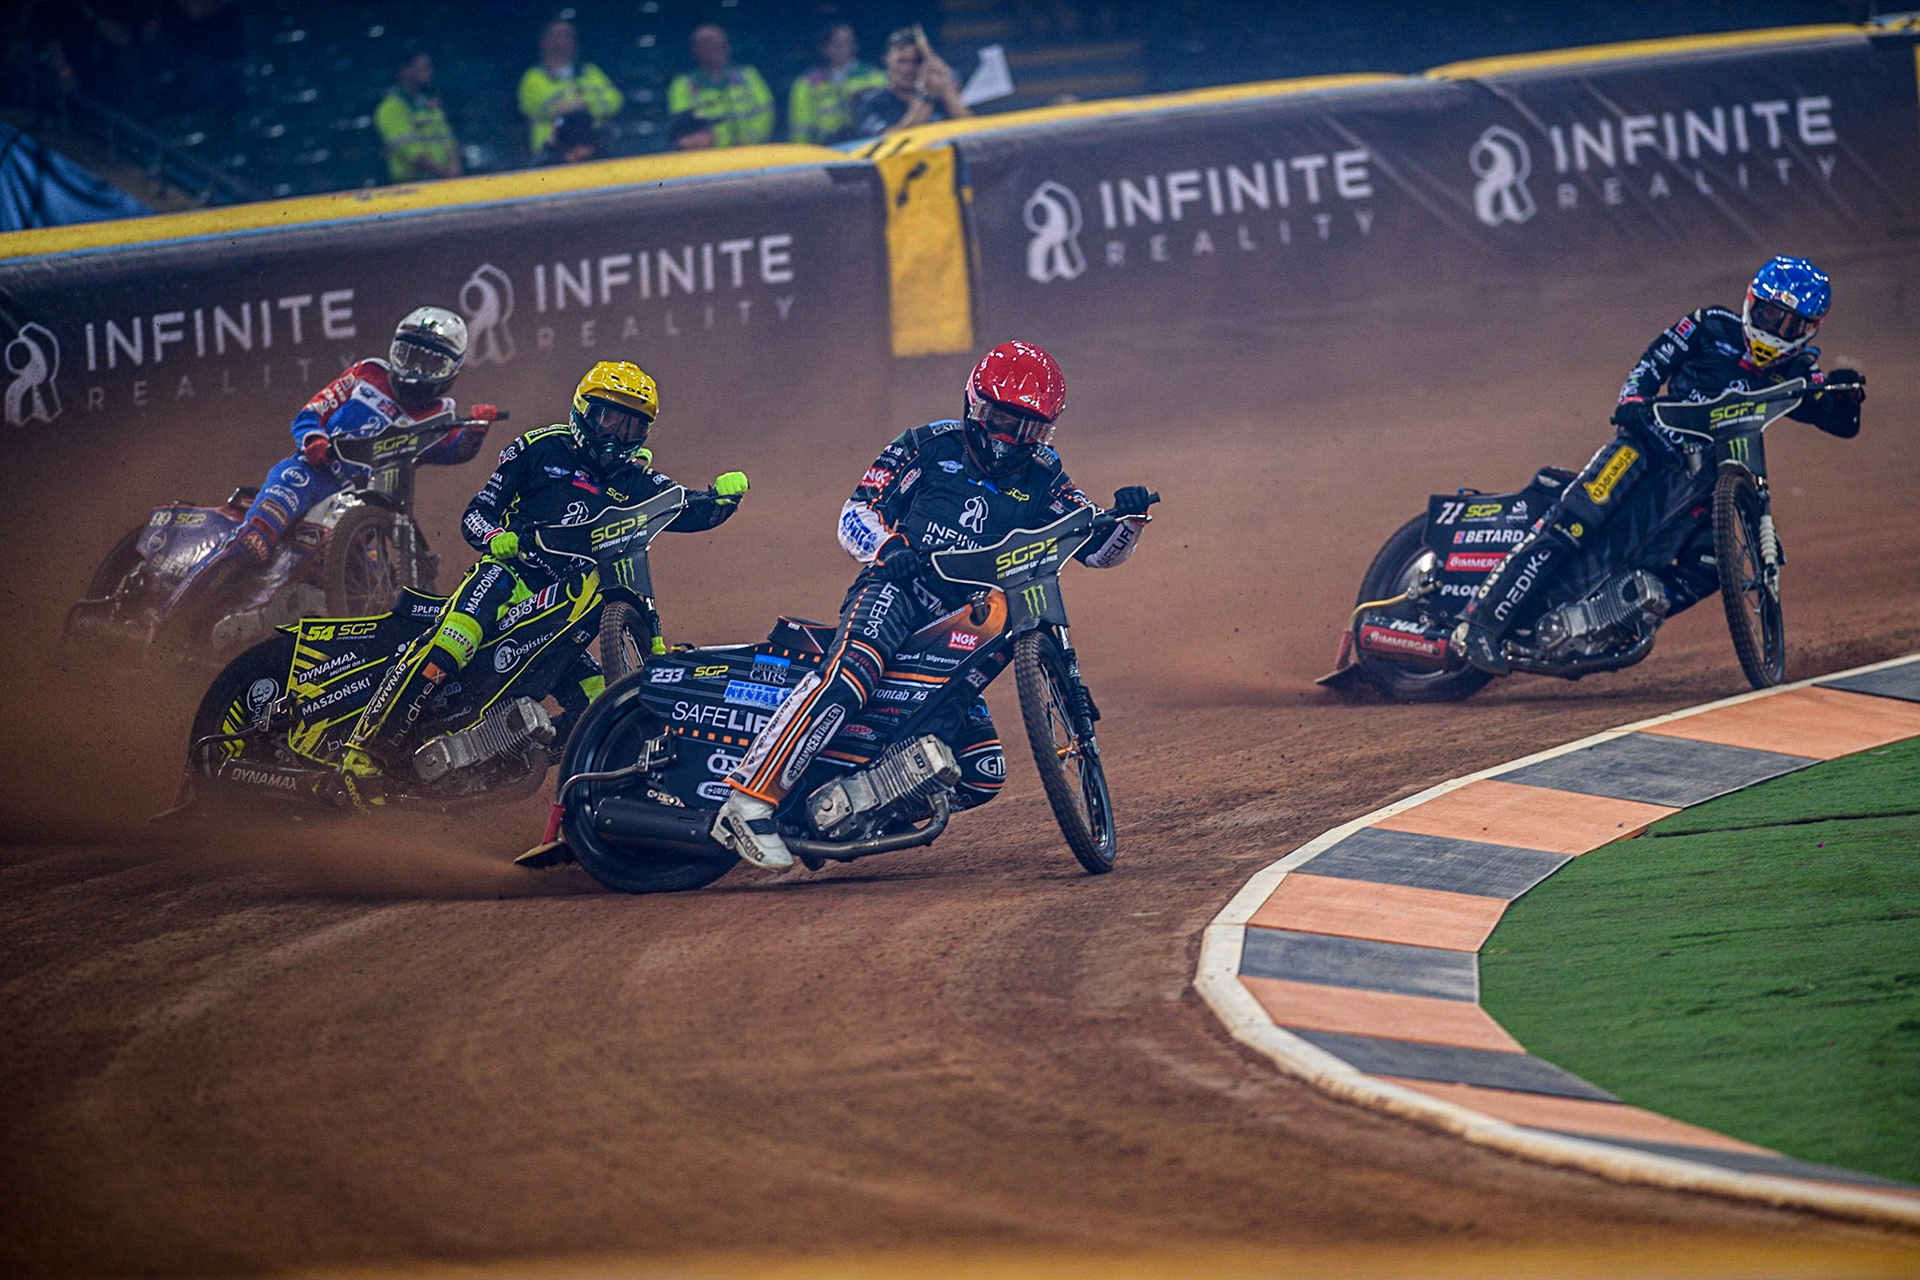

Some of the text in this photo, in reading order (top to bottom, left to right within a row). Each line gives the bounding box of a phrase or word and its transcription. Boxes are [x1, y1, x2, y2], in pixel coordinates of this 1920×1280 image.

[1551, 96, 1837, 173] INFINITE
[1100, 150, 1374, 229] INFINITE
[1558, 156, 1836, 210] REALITY
[1105, 210, 1375, 266] REALITY
[534, 233, 794, 314] INFINITE
[85, 289, 357, 372] INFINITE
[537, 295, 795, 348] REALITY
[88, 354, 356, 412] REALITY
[1465, 503, 1503, 518] SGP
[591, 517, 636, 546] SGP
[1465, 529, 1525, 543] BETARD
[995, 540, 1046, 572] SGP
[411, 604, 444, 615] 3PLFR
[863, 582, 900, 639] SAFELIFT
[305, 625, 337, 642] 54
[337, 622, 378, 637] SGP
[951, 631, 979, 646] NGK
[299, 651, 358, 684] DYNAMAX
[651, 668, 686, 684] 233
[694, 665, 730, 678] SGP
[750, 669, 787, 684] CARS
[302, 677, 371, 716] MASZOŃSKI
[671, 700, 772, 734] SAFELIF
[231, 768, 297, 791] DYNAMAX
[732, 816, 766, 862] daytona
